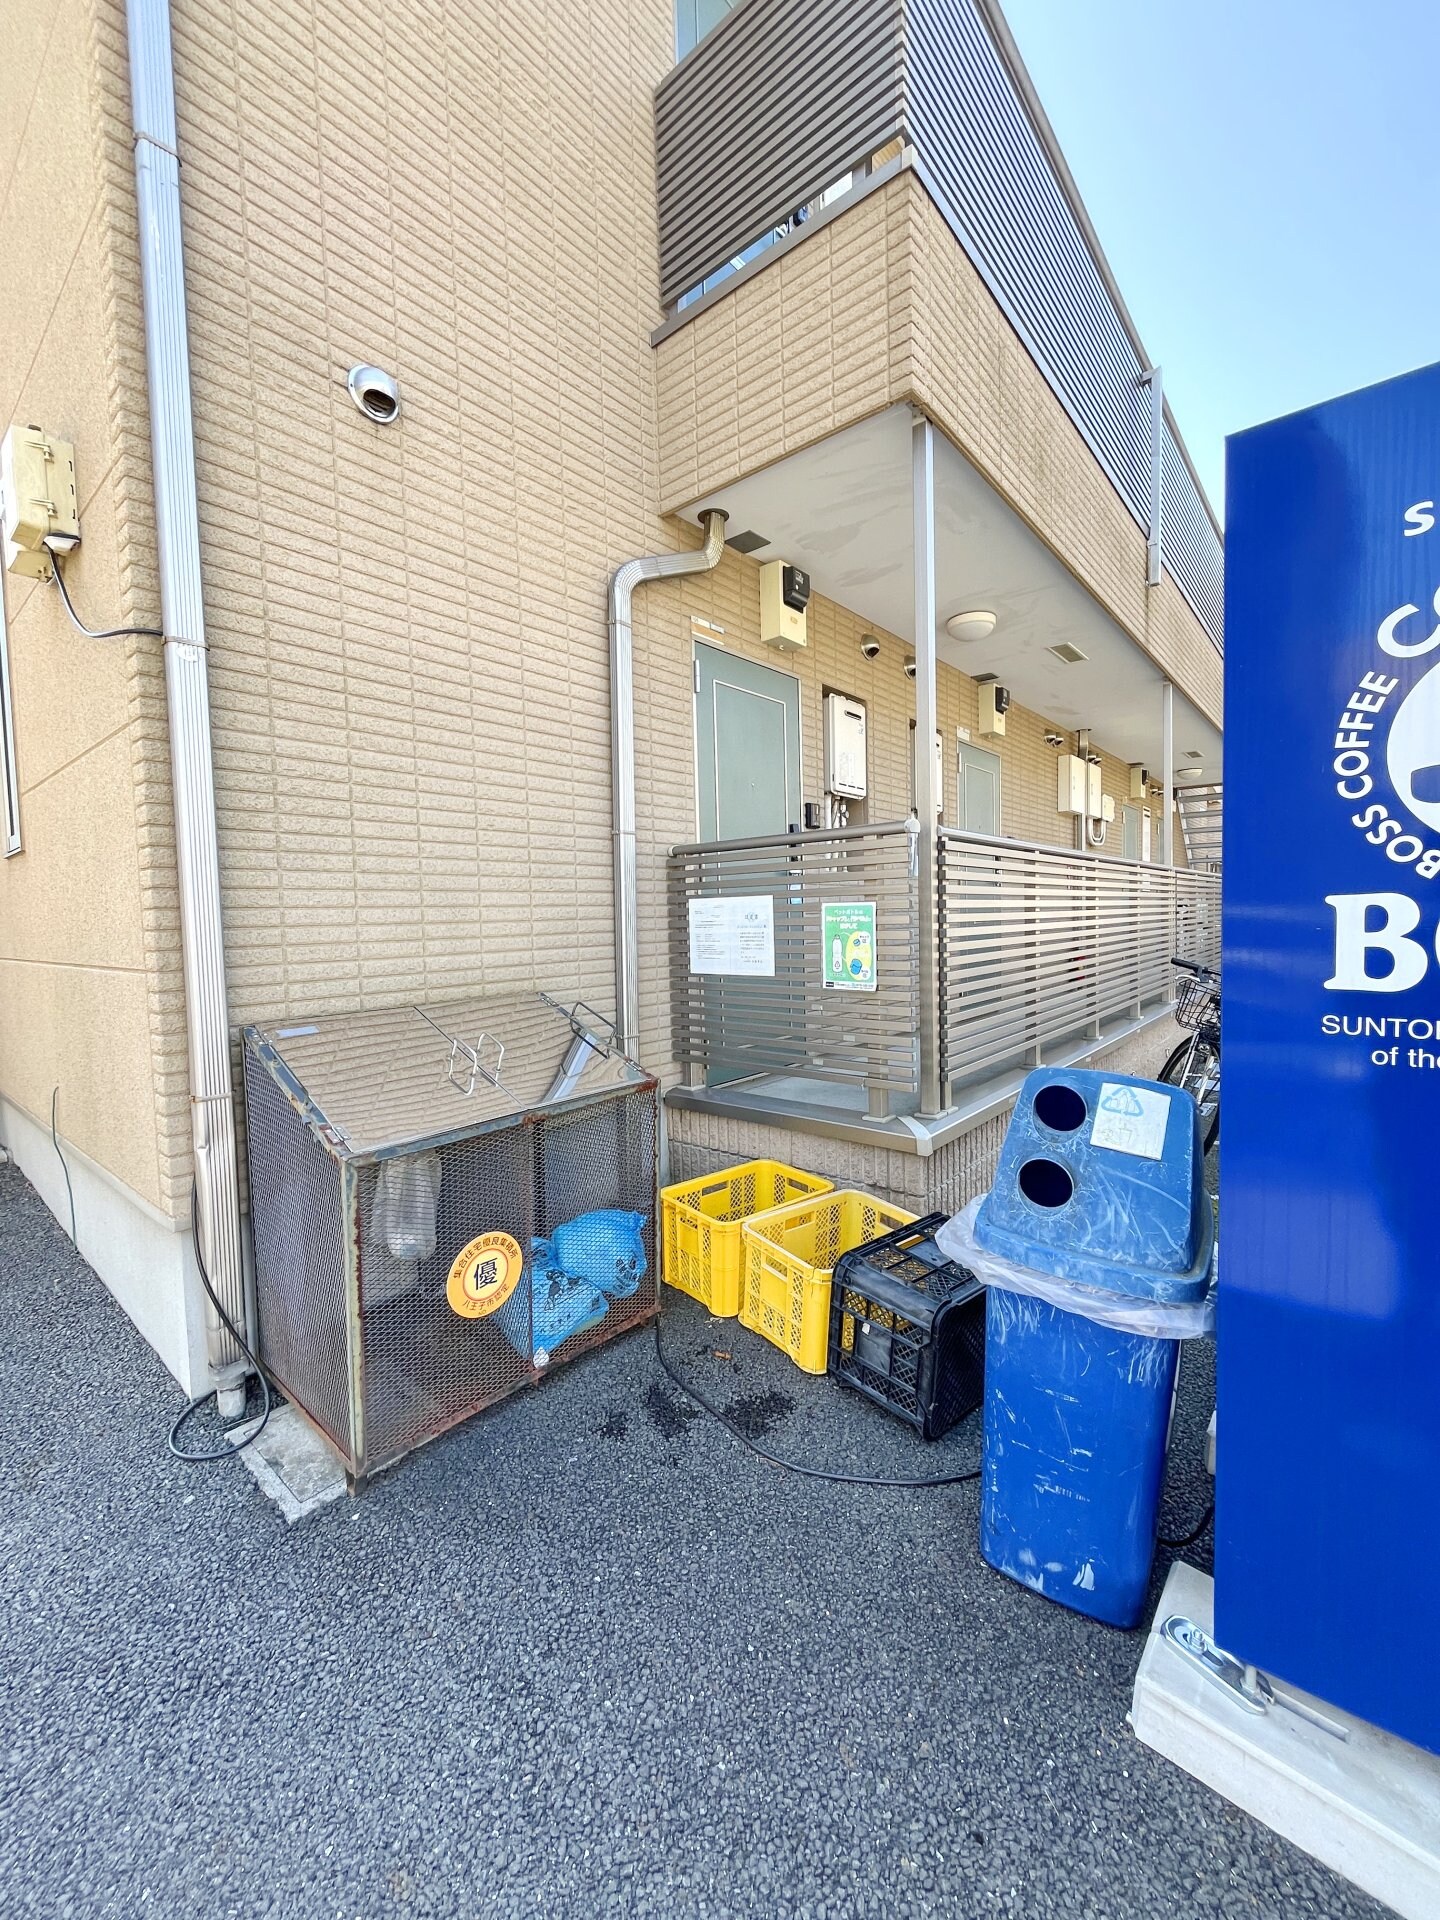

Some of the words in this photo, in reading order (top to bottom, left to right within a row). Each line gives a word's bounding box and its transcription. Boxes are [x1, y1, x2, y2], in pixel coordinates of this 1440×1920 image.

[1333, 670, 1400, 799] COFFEE
[1351, 804, 1440, 880] BOSS
[1323, 892, 1440, 993] B
[1321, 1014, 1440, 1041] SUNTO
[1371, 1046, 1399, 1066] of
[1407, 1048, 1440, 1069] th
[473, 1257, 498, 1291] 優
